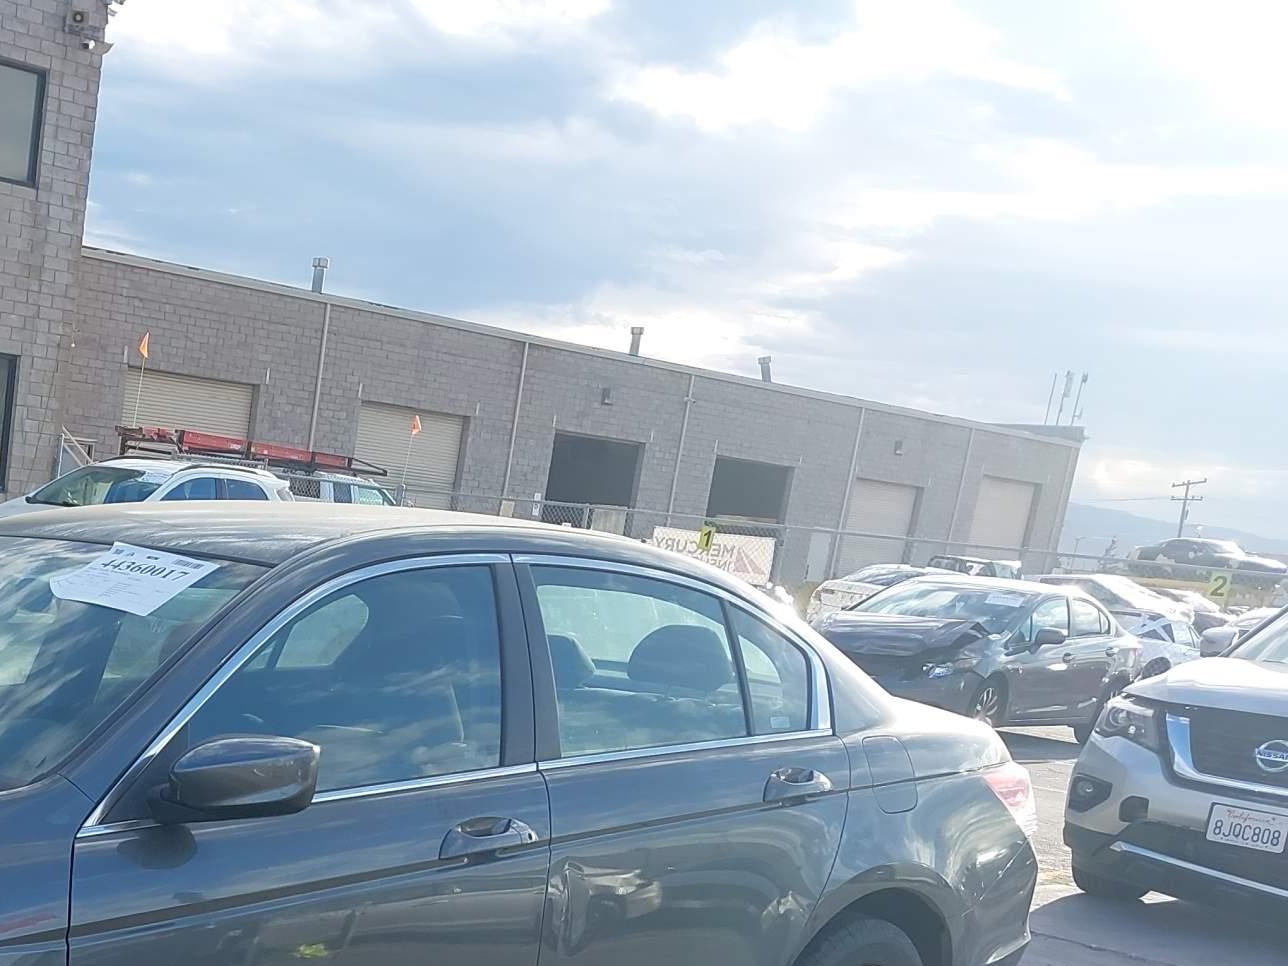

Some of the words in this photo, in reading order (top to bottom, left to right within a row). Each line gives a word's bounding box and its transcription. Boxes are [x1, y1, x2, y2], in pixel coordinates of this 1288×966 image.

[703, 529, 713, 548] 1
[101, 559, 190, 581] 44360017
[1209, 575, 1227, 597] 2
[1213, 820, 1281, 847] 8JQC808
